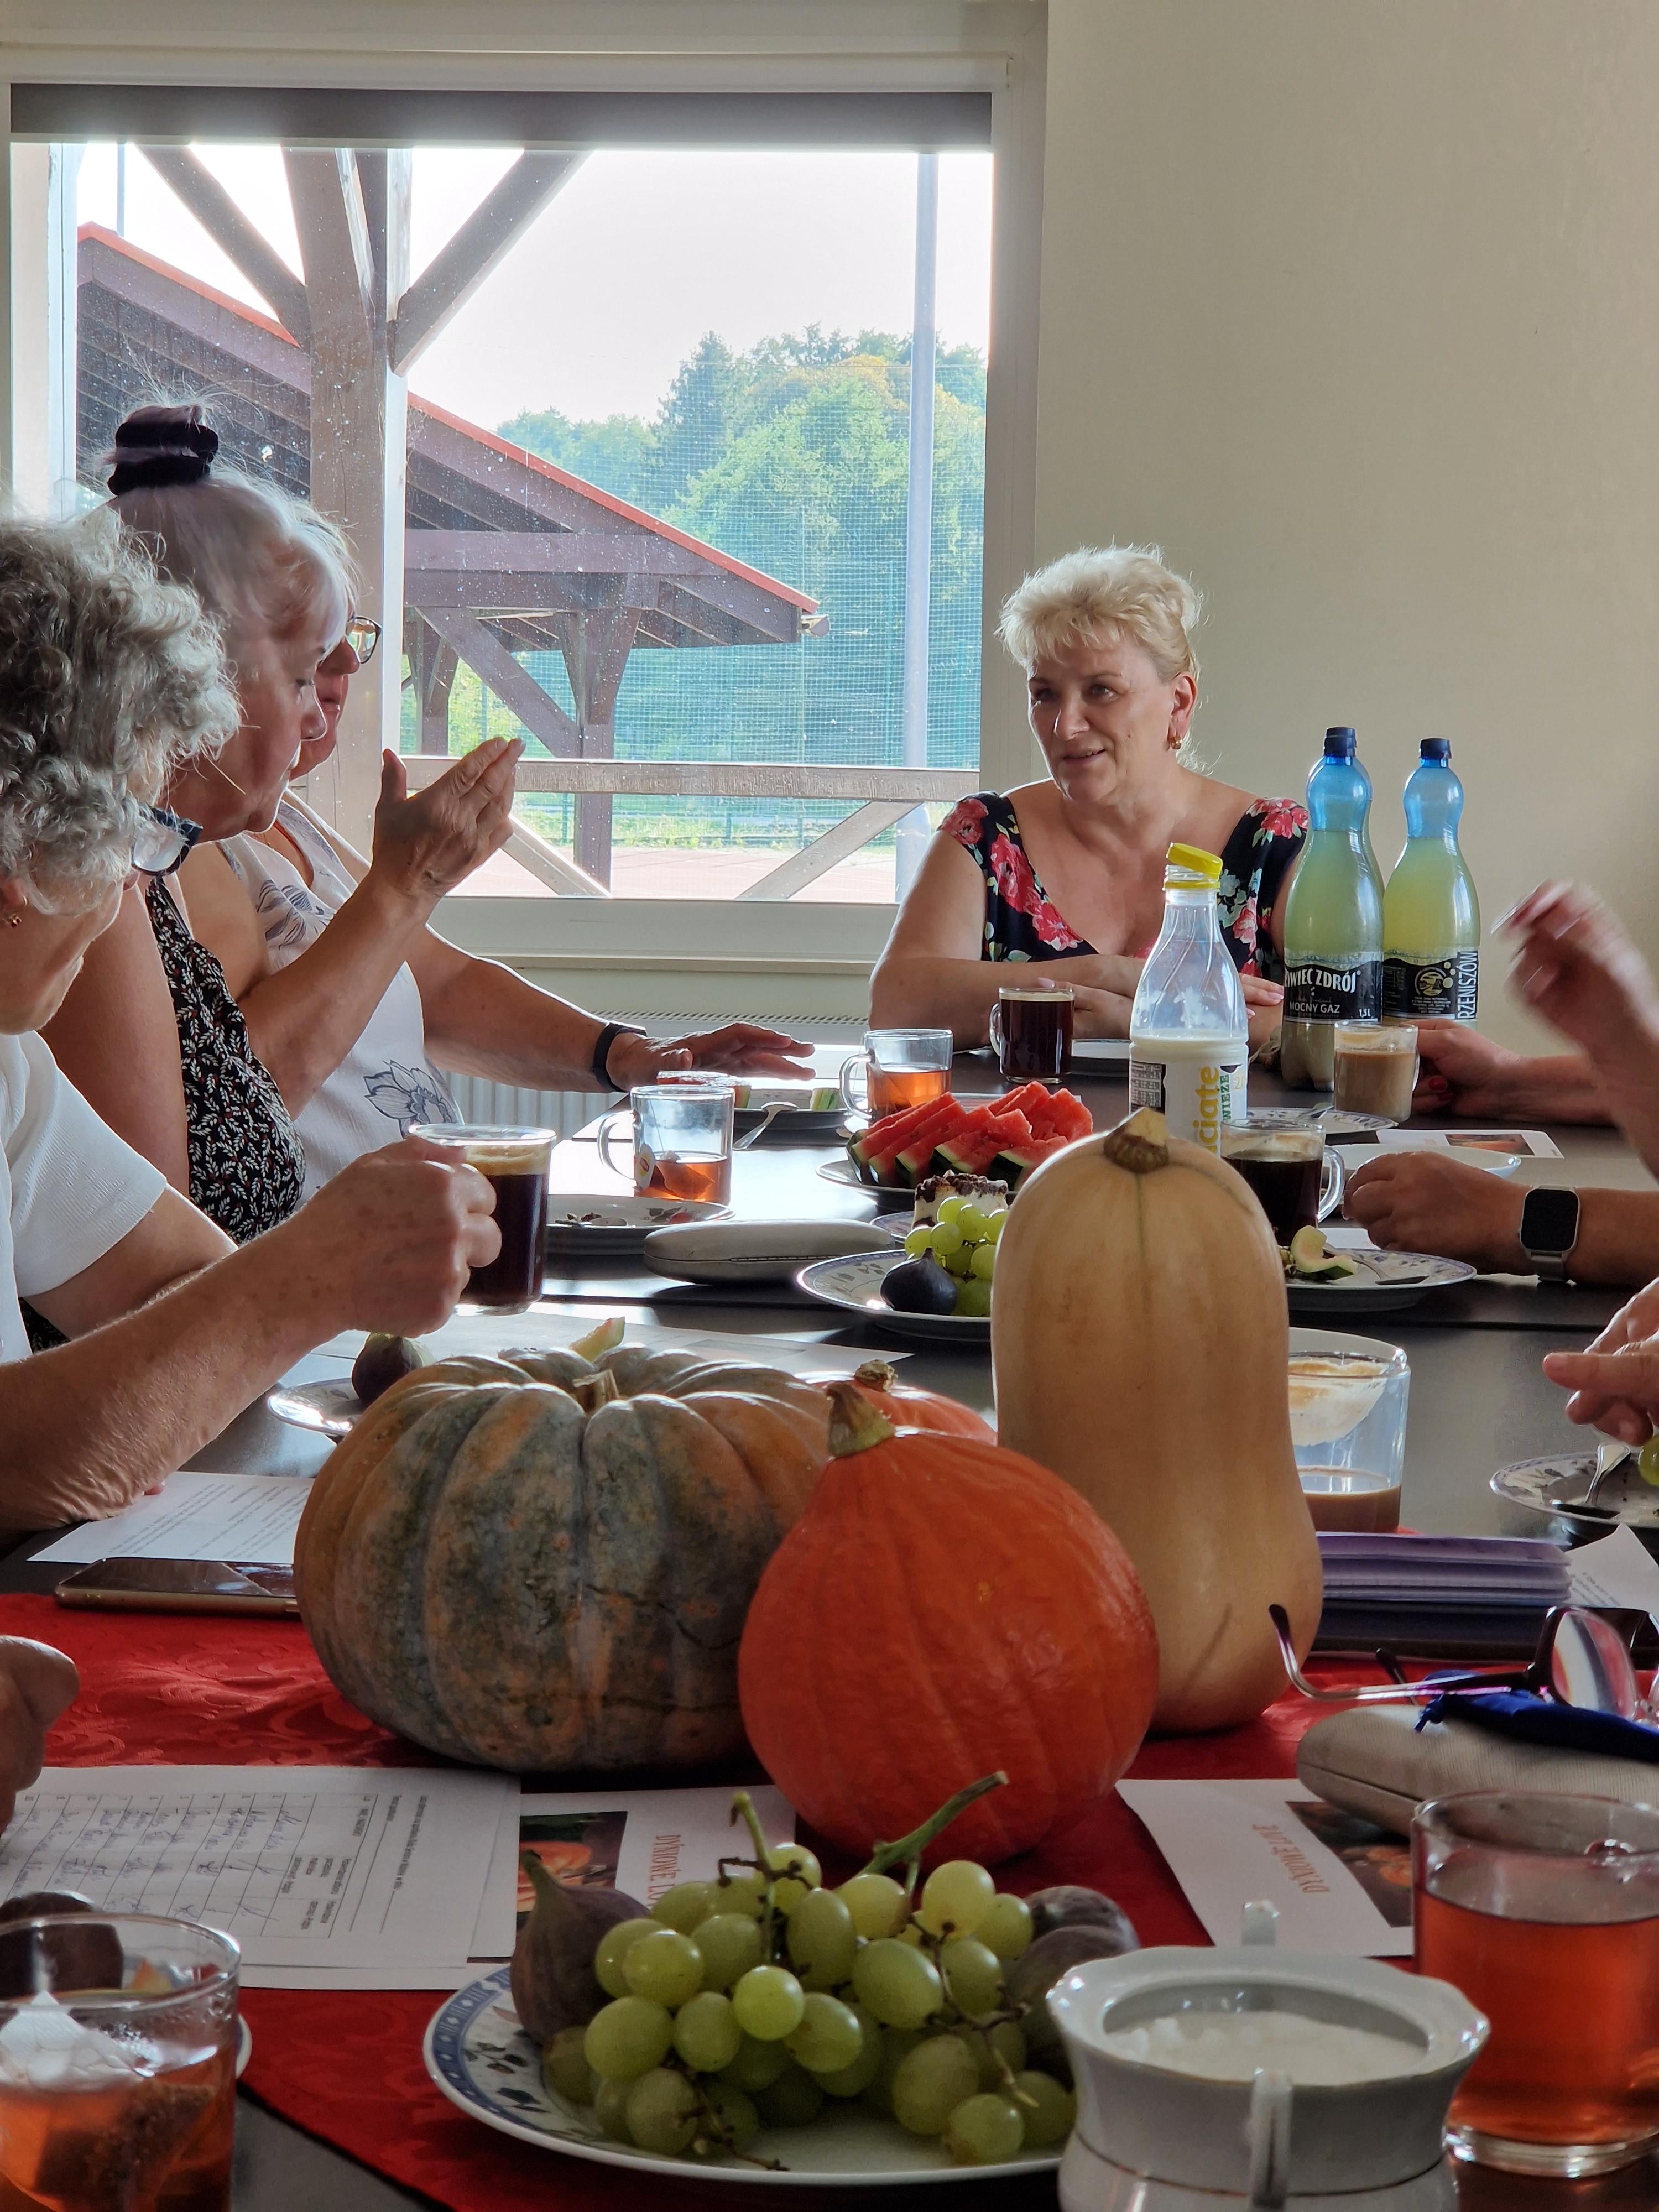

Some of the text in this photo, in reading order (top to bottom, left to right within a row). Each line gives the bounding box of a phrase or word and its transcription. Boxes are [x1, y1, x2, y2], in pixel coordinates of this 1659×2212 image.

[1316, 969, 1357, 993] ZDRÓJ
[1456, 952, 1478, 1019] RZENISZÓW
[1289, 1001, 1340, 1014] MOCNY GAZ
